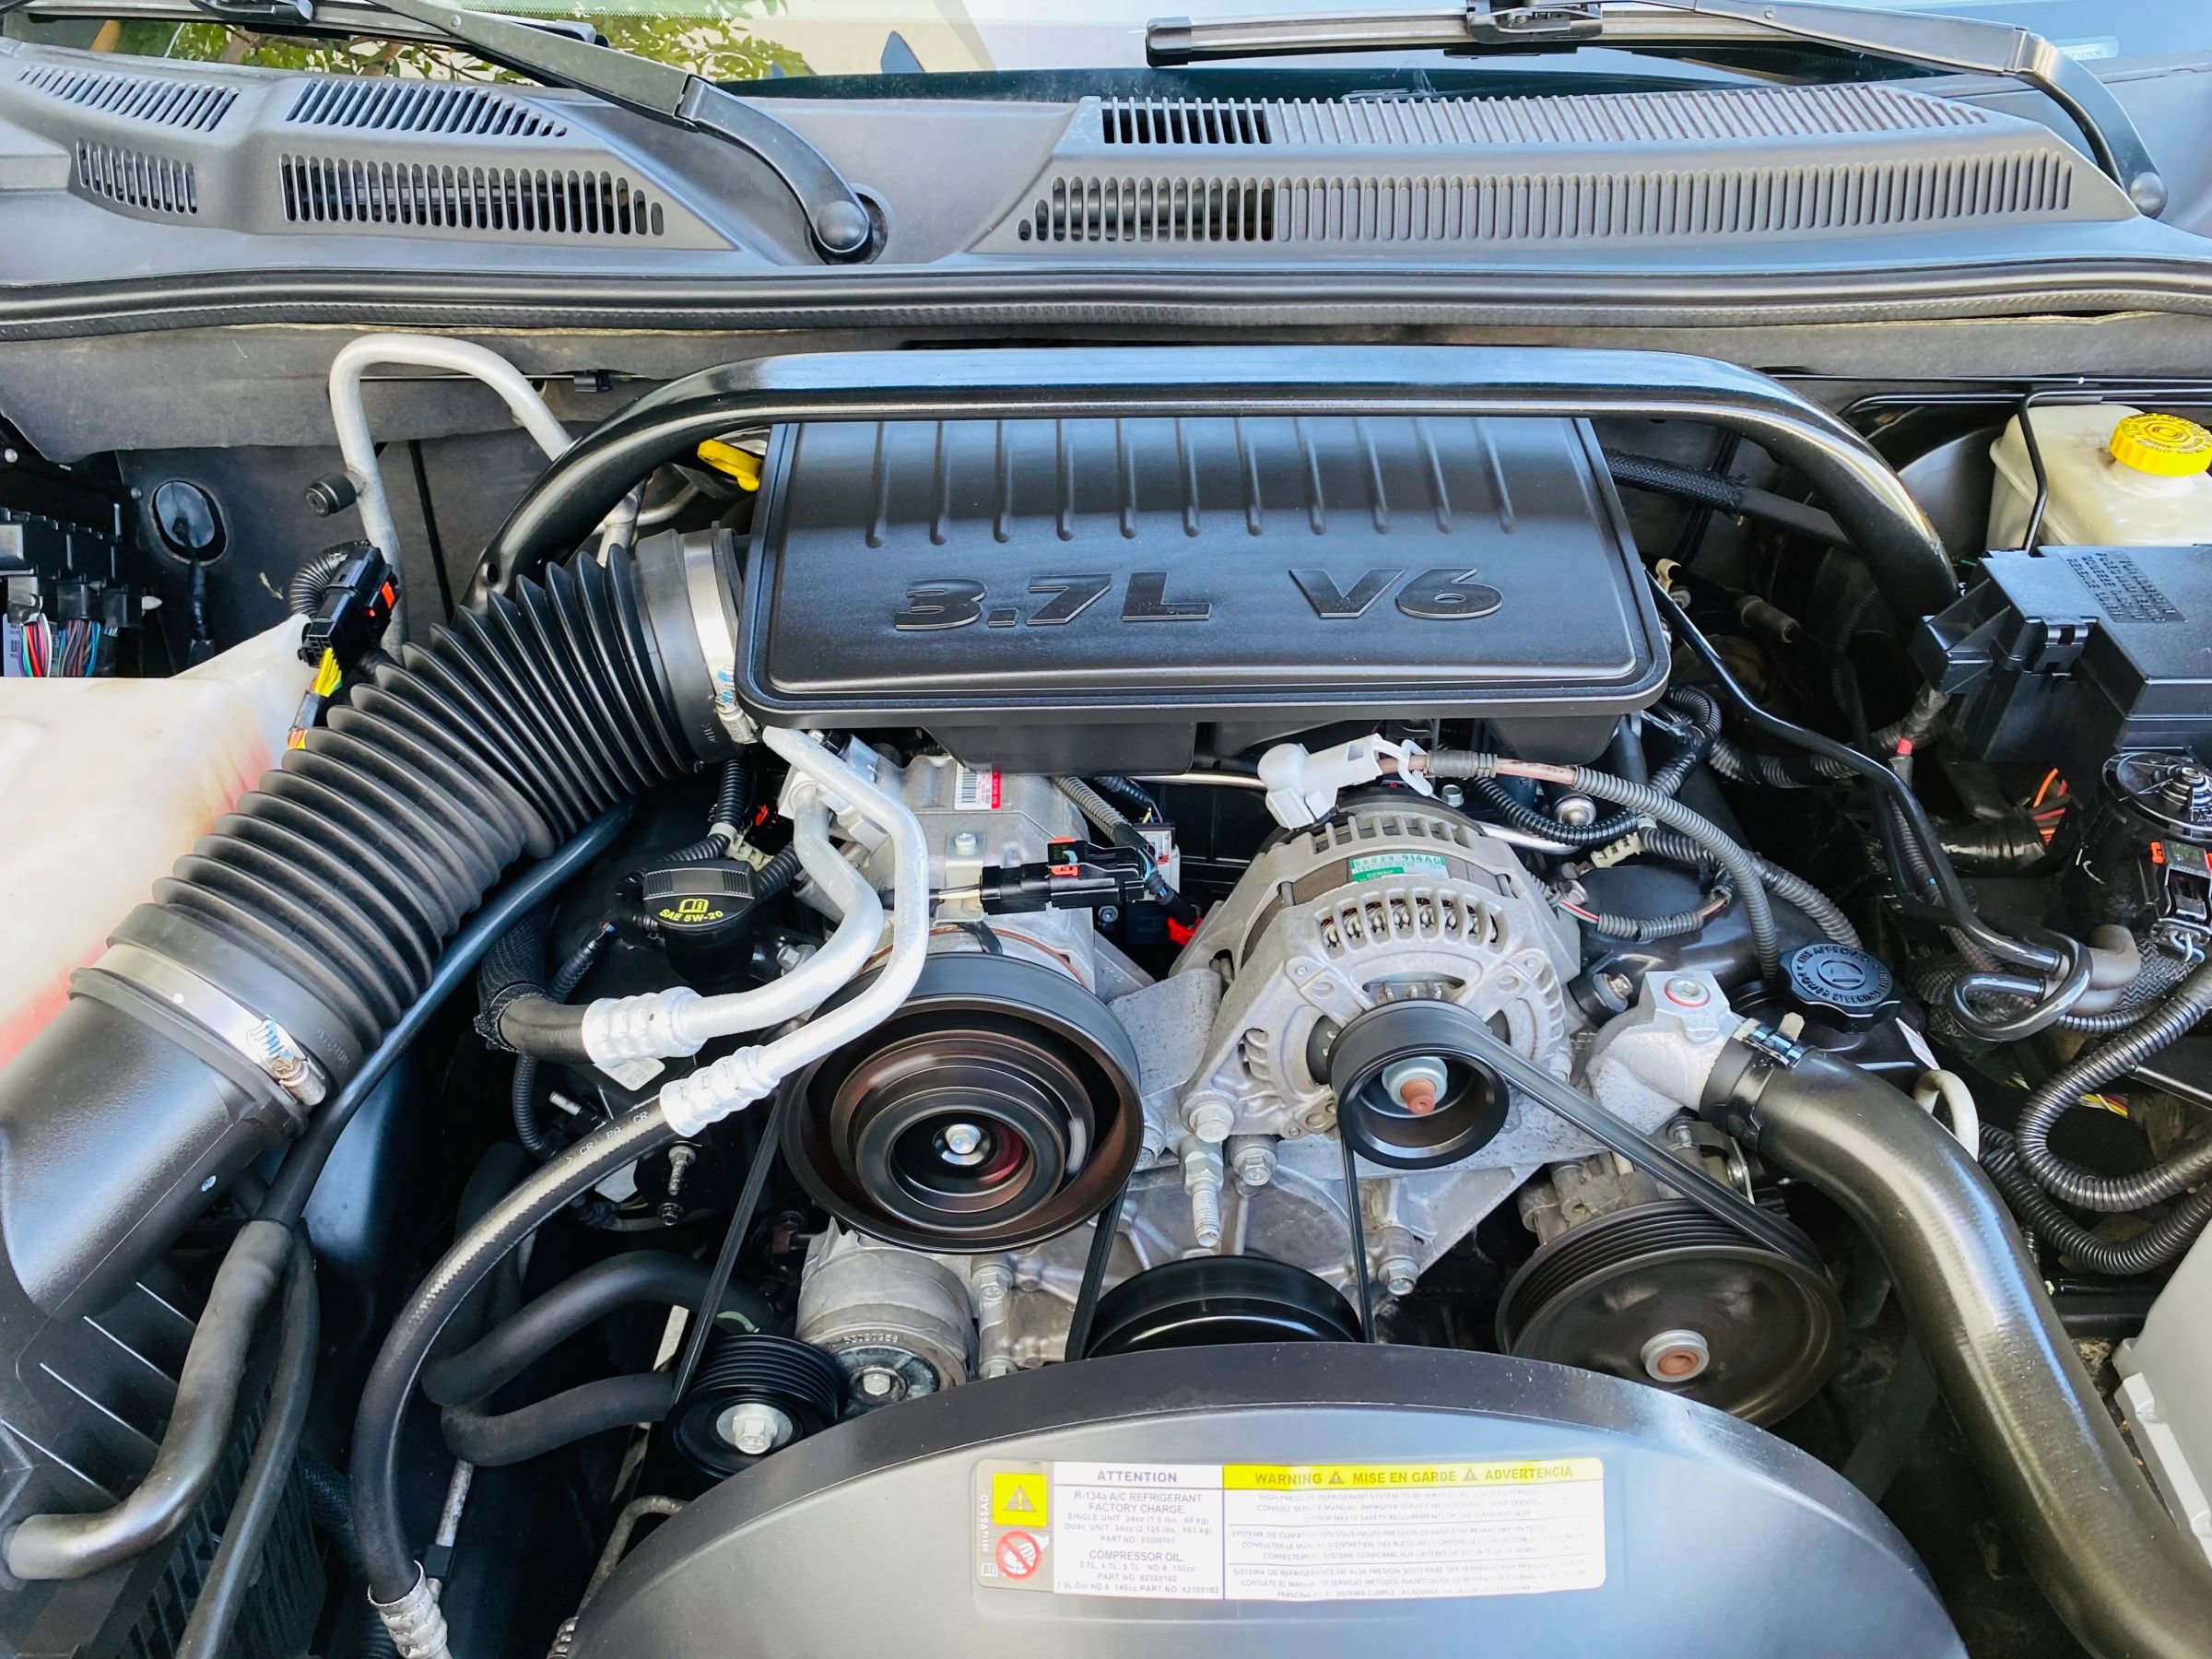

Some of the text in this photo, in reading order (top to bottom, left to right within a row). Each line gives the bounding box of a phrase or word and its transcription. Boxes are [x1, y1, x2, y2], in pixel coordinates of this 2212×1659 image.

[896, 568, 1503, 630] 3.7L V6
[658, 908, 724, 923] SAE 5W-20
[633, 1112, 649, 1124] CR
[1097, 1470, 1178, 1484] ATTENTION
[1254, 1465, 1573, 1485] WARNING MISE EN GARDE ADVERTENCIA
[1074, 1490, 1203, 1504] R-134a A/C REFRIGERANT
[1088, 1501, 1139, 1513] FACTORY
[1067, 1512, 1099, 1522] SINGLE
[1064, 1523, 1088, 1531] DUAL
[1100, 1535, 1122, 1543] PART
[1088, 1549, 1162, 1562] COMPRESSOR
[1097, 1571, 1120, 1581] PART
[1139, 1584, 1162, 1594] PART
